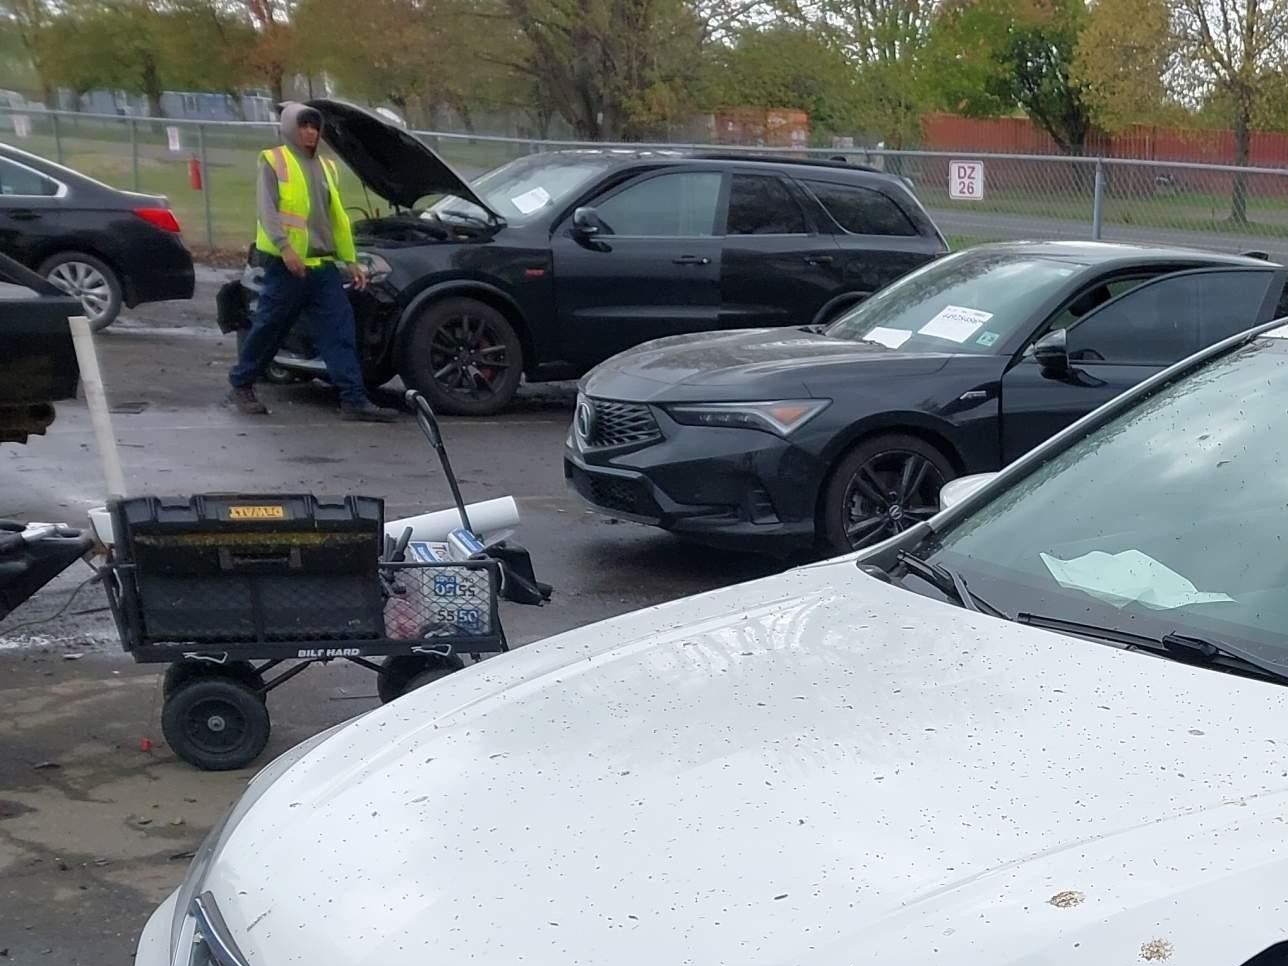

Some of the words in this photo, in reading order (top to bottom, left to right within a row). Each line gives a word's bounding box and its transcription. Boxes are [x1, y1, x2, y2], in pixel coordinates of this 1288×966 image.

[957, 166, 976, 180] DZ
[959, 181, 975, 194] 26
[326, 648, 361, 657] HARD
